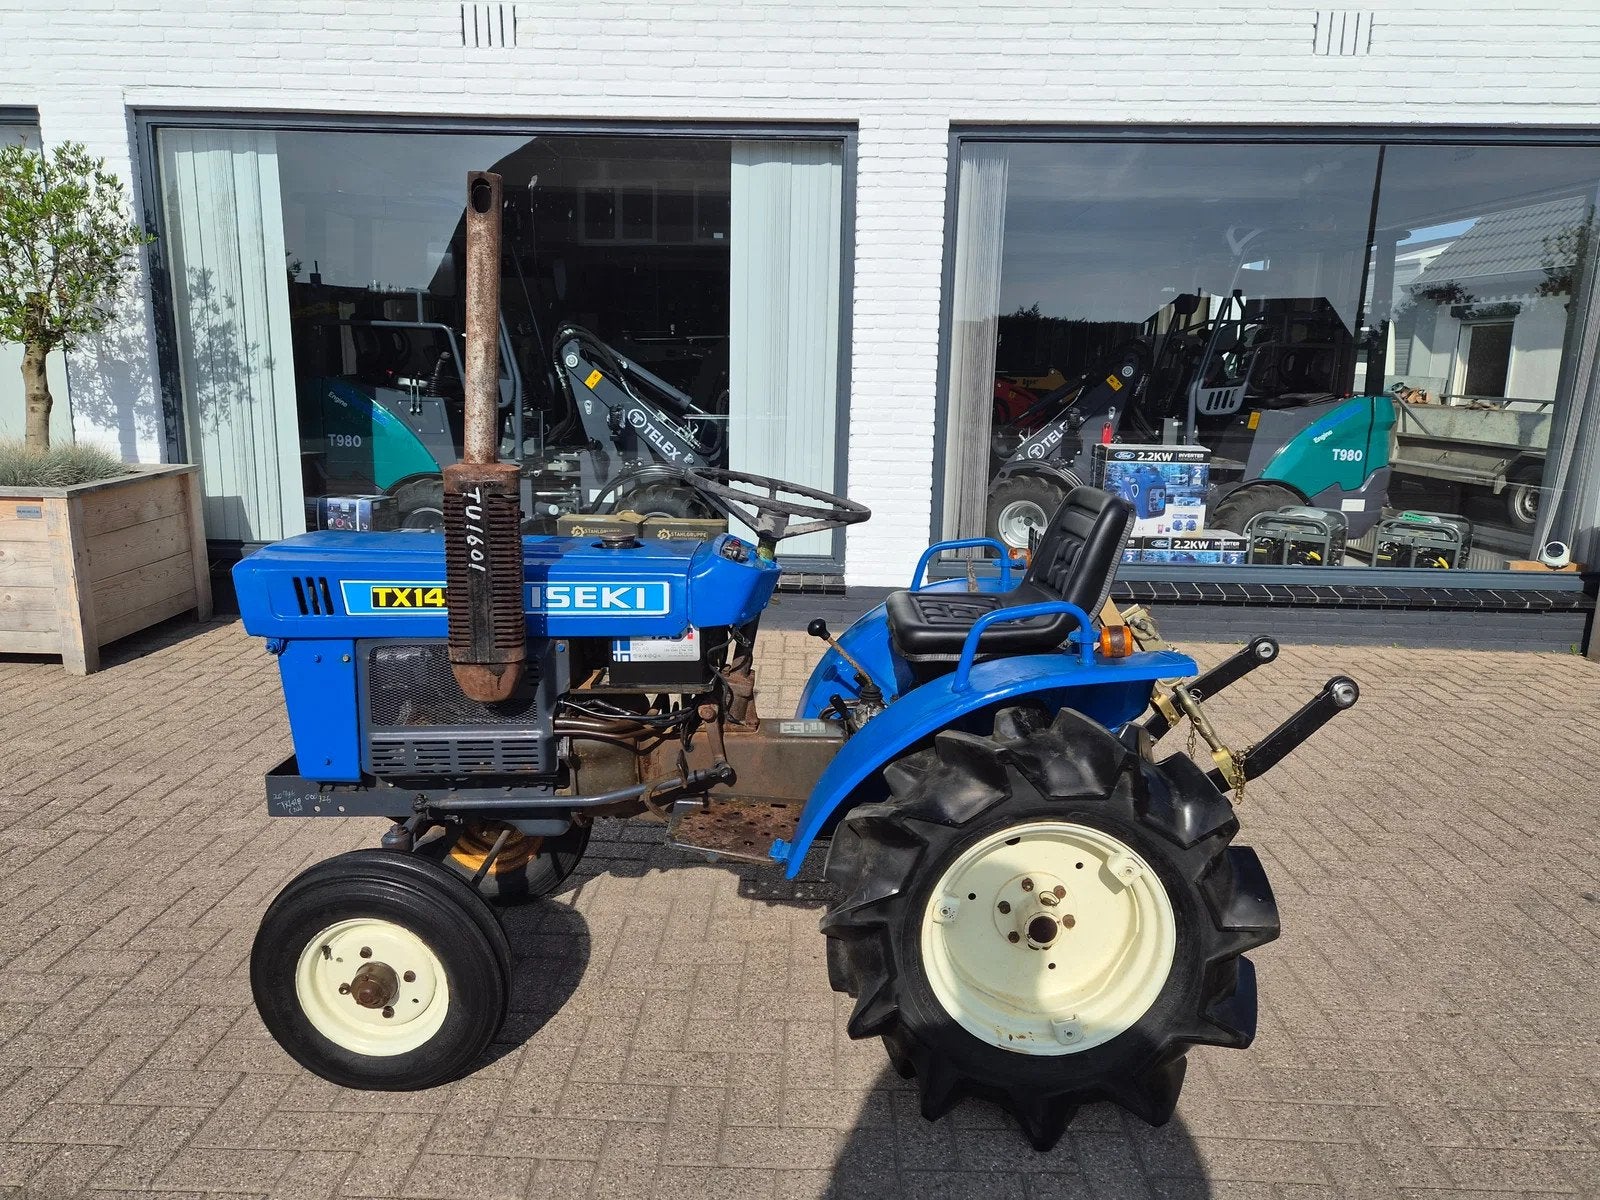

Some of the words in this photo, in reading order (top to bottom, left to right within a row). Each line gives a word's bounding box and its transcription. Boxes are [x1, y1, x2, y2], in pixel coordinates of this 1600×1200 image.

[327, 391, 348, 408] Engine
[327, 433, 362, 448] T980
[643, 423, 681, 461] TELEX
[1313, 429, 1333, 444] Engine
[1116, 451, 1134, 460] Ford
[1137, 451, 1174, 462] 2.2KW
[1332, 448, 1363, 462] T980
[1173, 540, 1210, 550] 2.2KW
[373, 588, 446, 607] TX14
[531, 587, 646, 609] ISEKI
